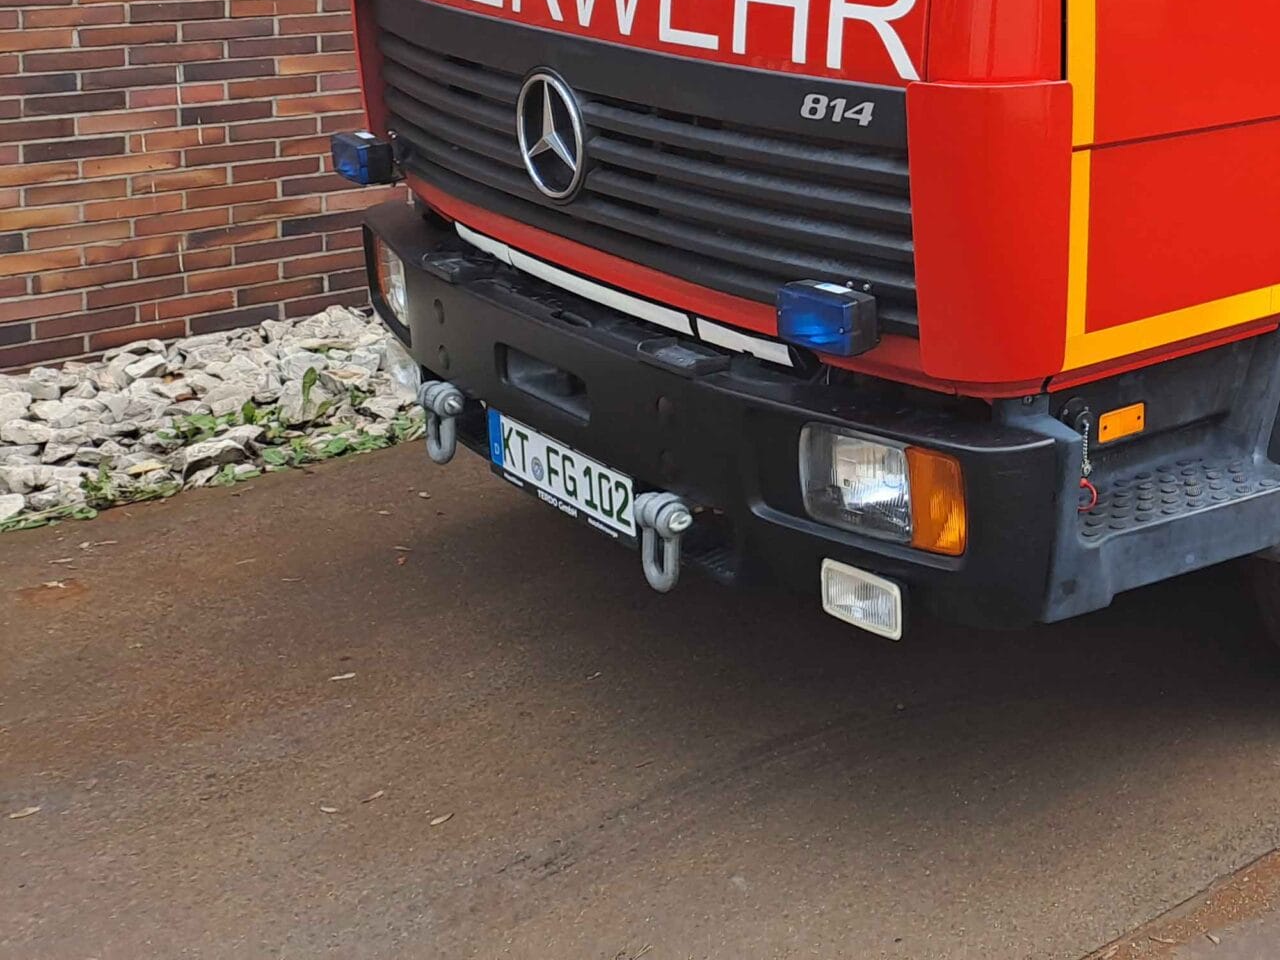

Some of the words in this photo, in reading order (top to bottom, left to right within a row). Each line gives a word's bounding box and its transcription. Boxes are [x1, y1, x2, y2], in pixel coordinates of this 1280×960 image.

[800, 94, 875, 128] 814
[493, 442, 501, 455] D
[502, 422, 528, 472] KT
